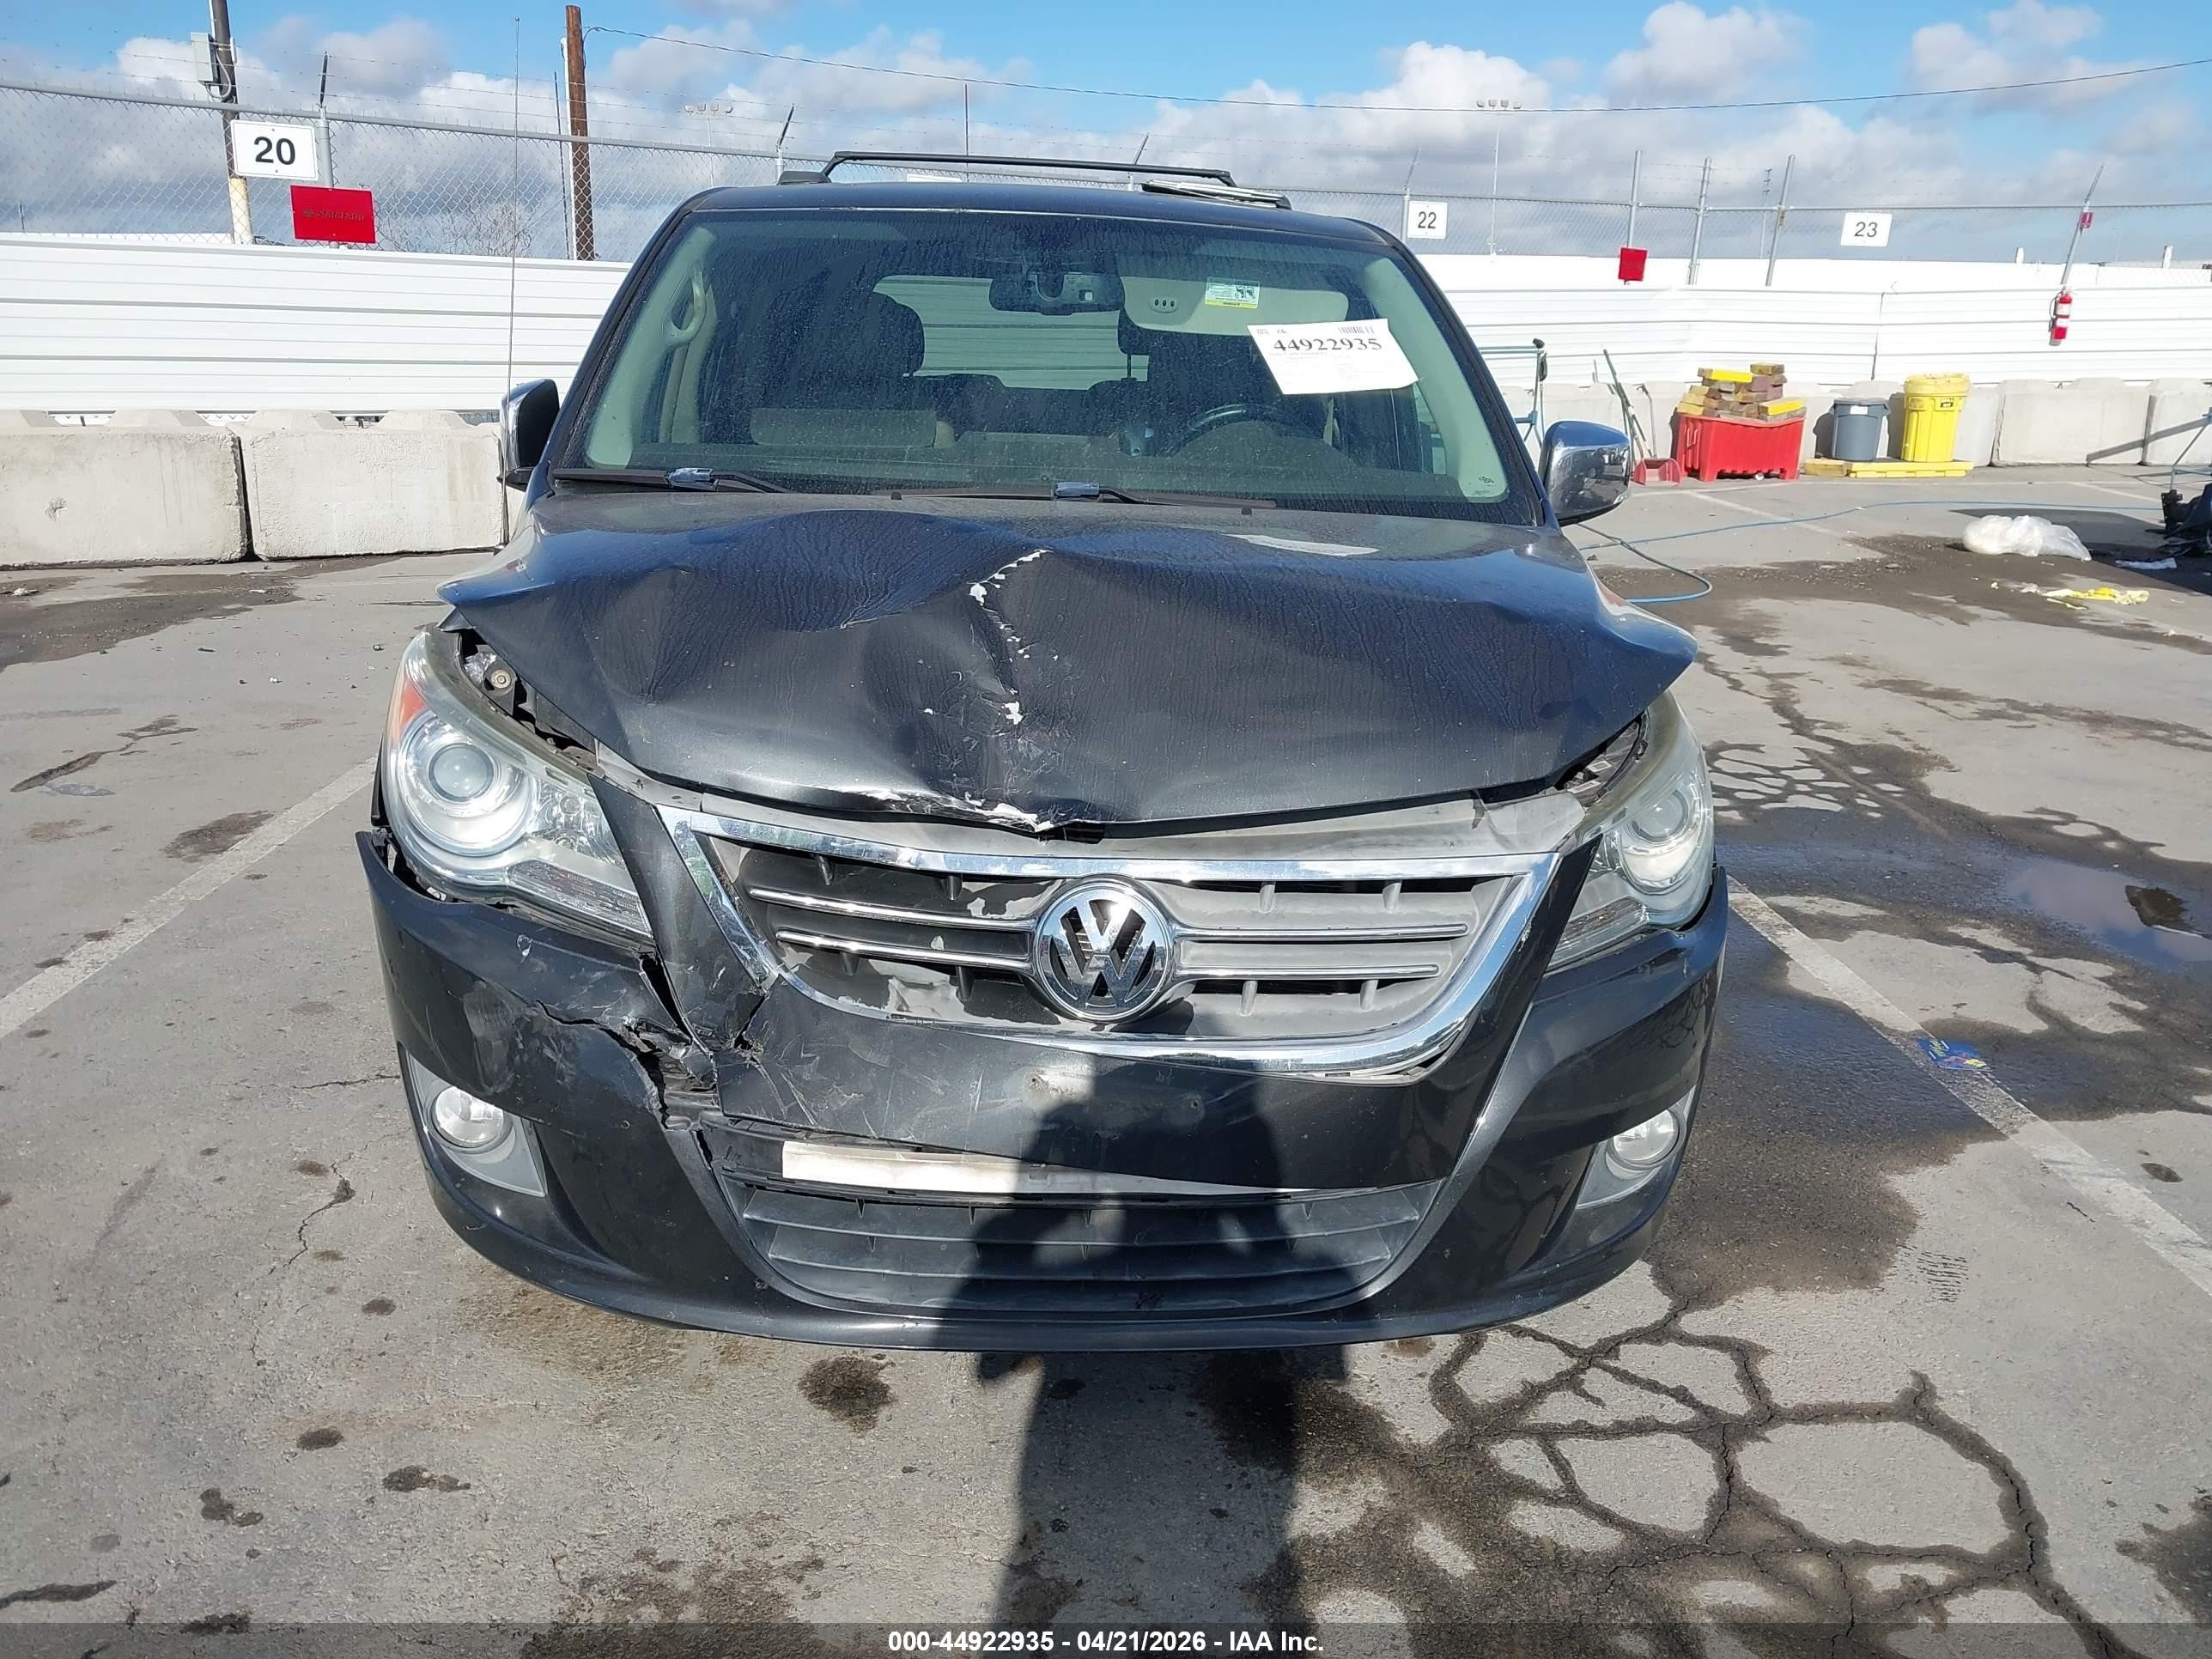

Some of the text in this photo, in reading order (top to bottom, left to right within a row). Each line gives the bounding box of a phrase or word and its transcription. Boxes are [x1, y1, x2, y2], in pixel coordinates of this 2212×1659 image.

[253, 136, 295, 166] 20
[1418, 211, 1437, 229] 22
[1854, 221, 1878, 238] 23
[1273, 337, 1382, 351] 44922935
